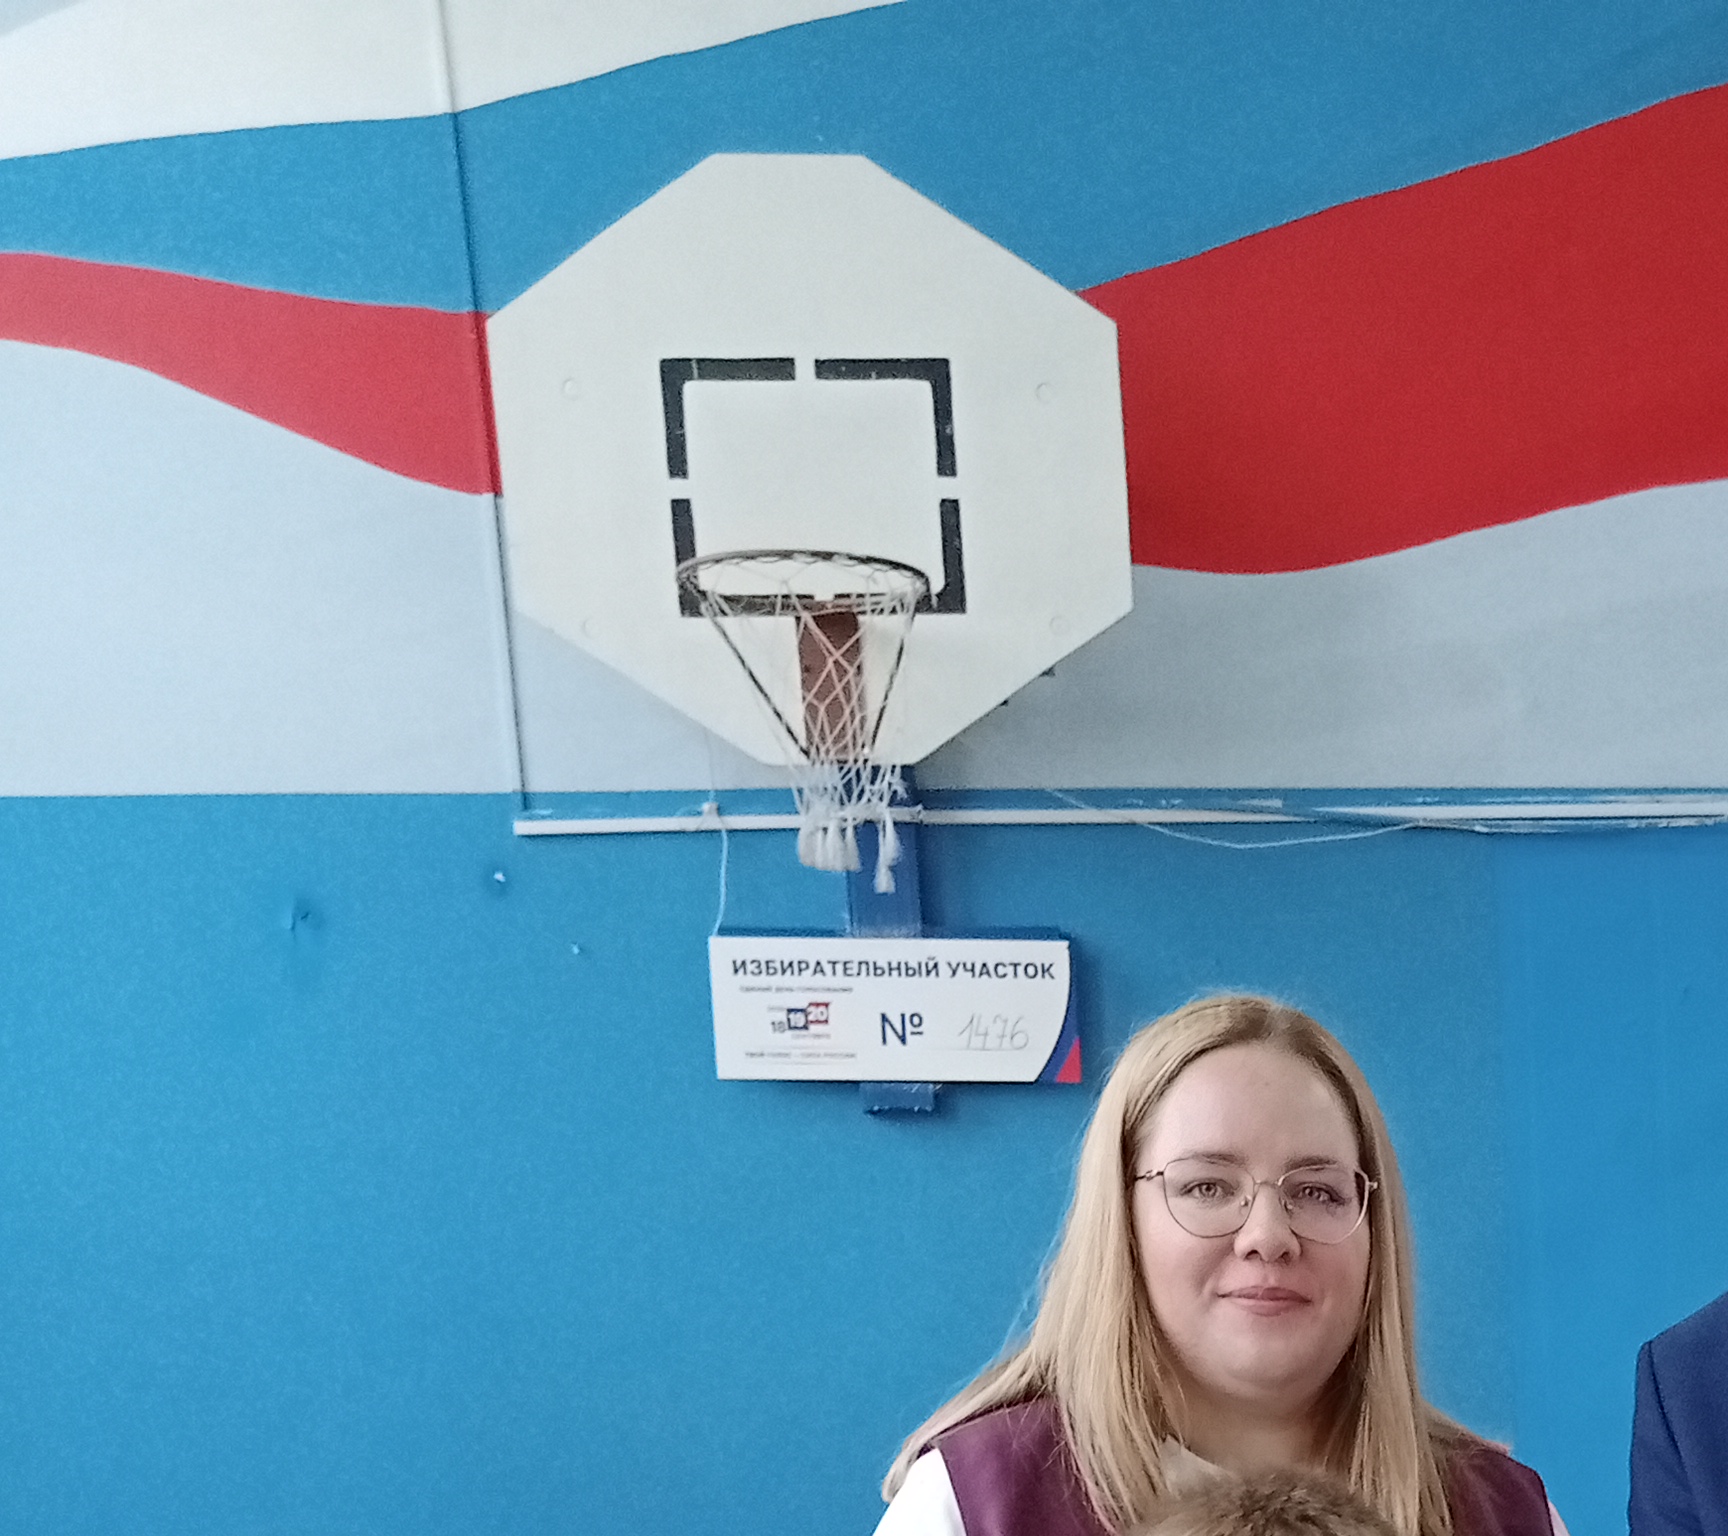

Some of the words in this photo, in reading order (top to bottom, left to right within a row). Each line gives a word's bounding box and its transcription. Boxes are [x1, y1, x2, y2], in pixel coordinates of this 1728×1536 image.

[732, 956, 940, 979] ИЗБИРАТЕЛЬНЫЙ
[947, 962, 1056, 980] УЧАСТОК
[880, 1012, 924, 1046] №
[957, 1013, 1030, 1050] 1476
